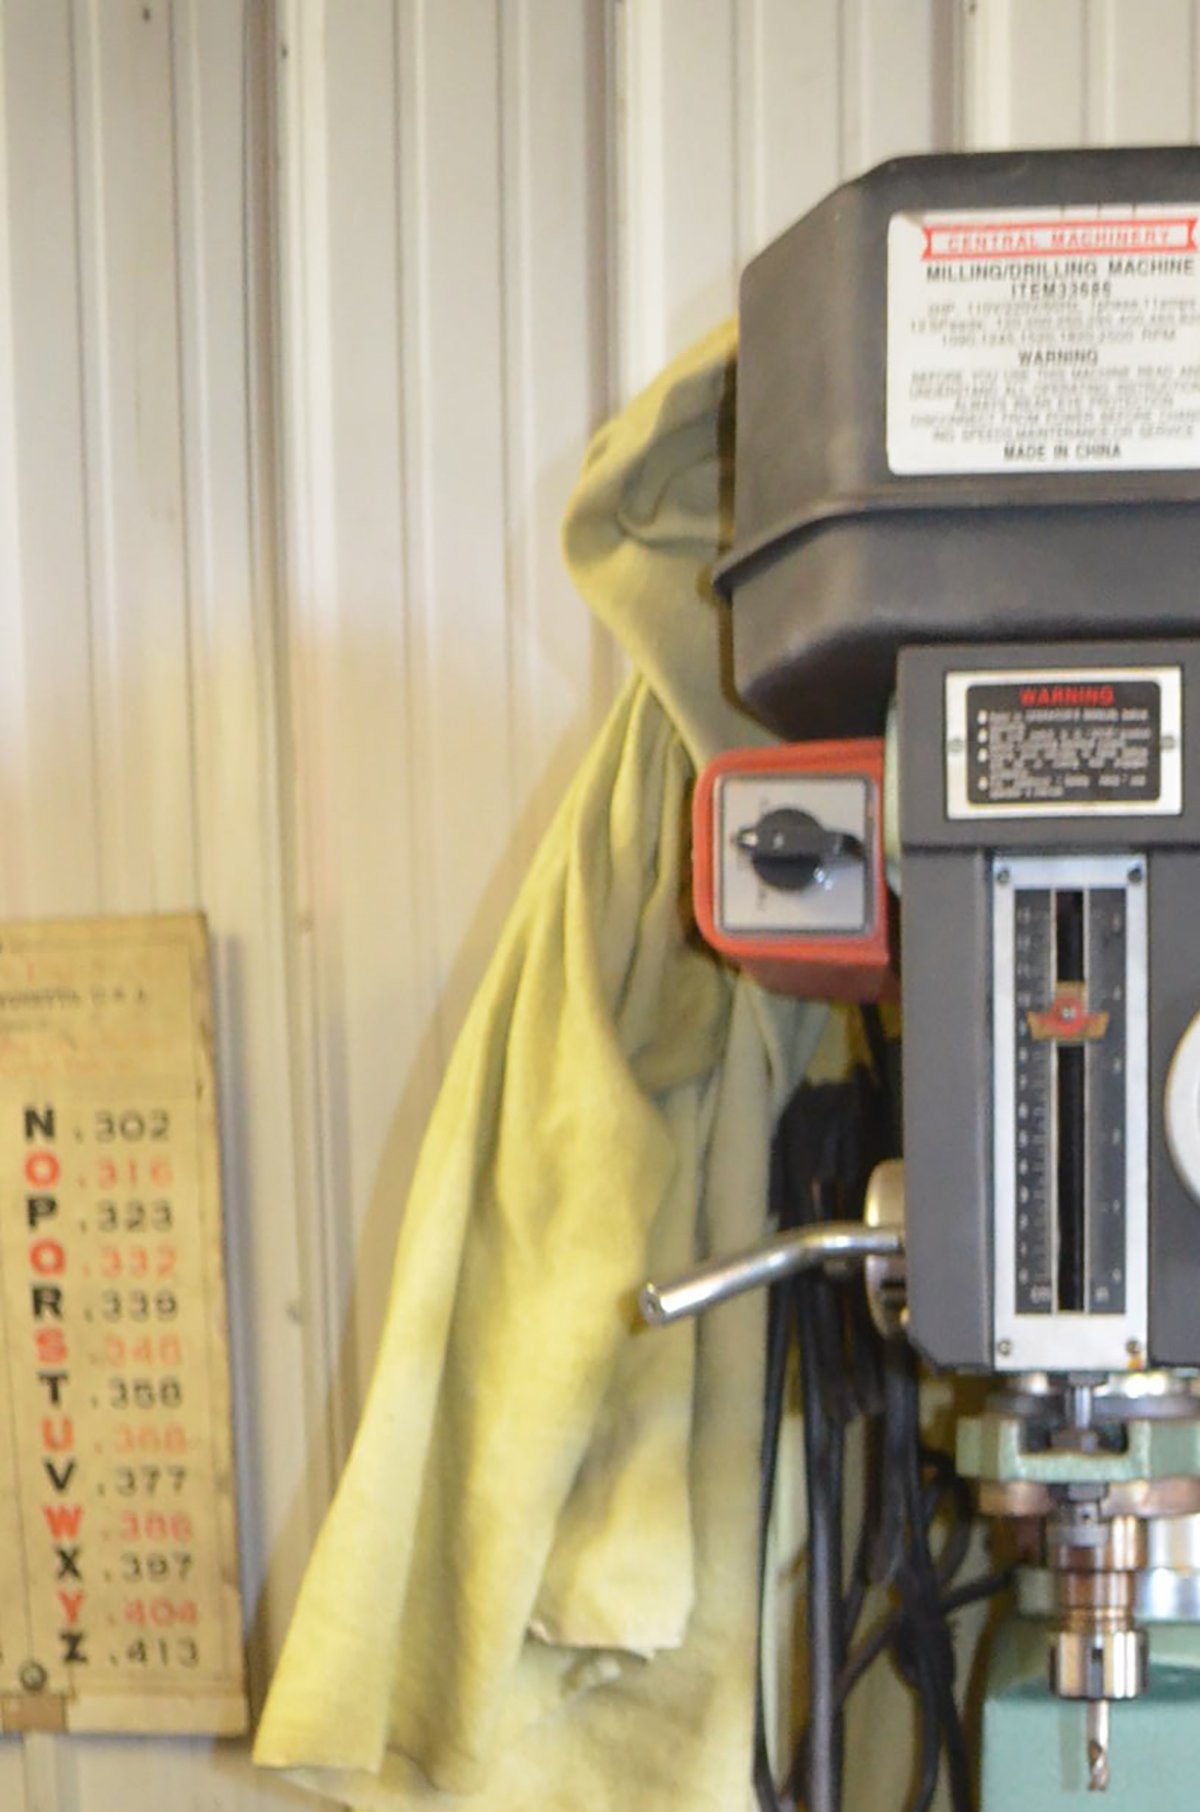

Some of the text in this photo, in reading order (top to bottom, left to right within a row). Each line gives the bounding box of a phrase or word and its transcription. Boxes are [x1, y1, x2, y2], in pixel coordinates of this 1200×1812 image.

[948, 230, 1169, 252] CENTRAL MACHINERY
[926, 257, 1195, 282] MILLING/DRILLING MACHINE
[1018, 349, 1099, 366] WARNING
[1003, 443, 1122, 462] MADE IN CHINA
[1020, 686, 1115, 706] WARNING
[24, 1108, 170, 1142] N .302
[24, 1151, 173, 1191] O .316
[27, 1199, 173, 1232] P .323
[32, 1285, 62, 1317] R
[35, 1327, 67, 1365] S
[37, 1371, 69, 1404] T
[42, 1416, 74, 1452] U
[43, 1457, 76, 1491] V
[43, 1505, 82, 1540] W
[56, 1548, 82, 1580] X
[58, 1592, 86, 1625] Y
[61, 1632, 89, 1665] Z
